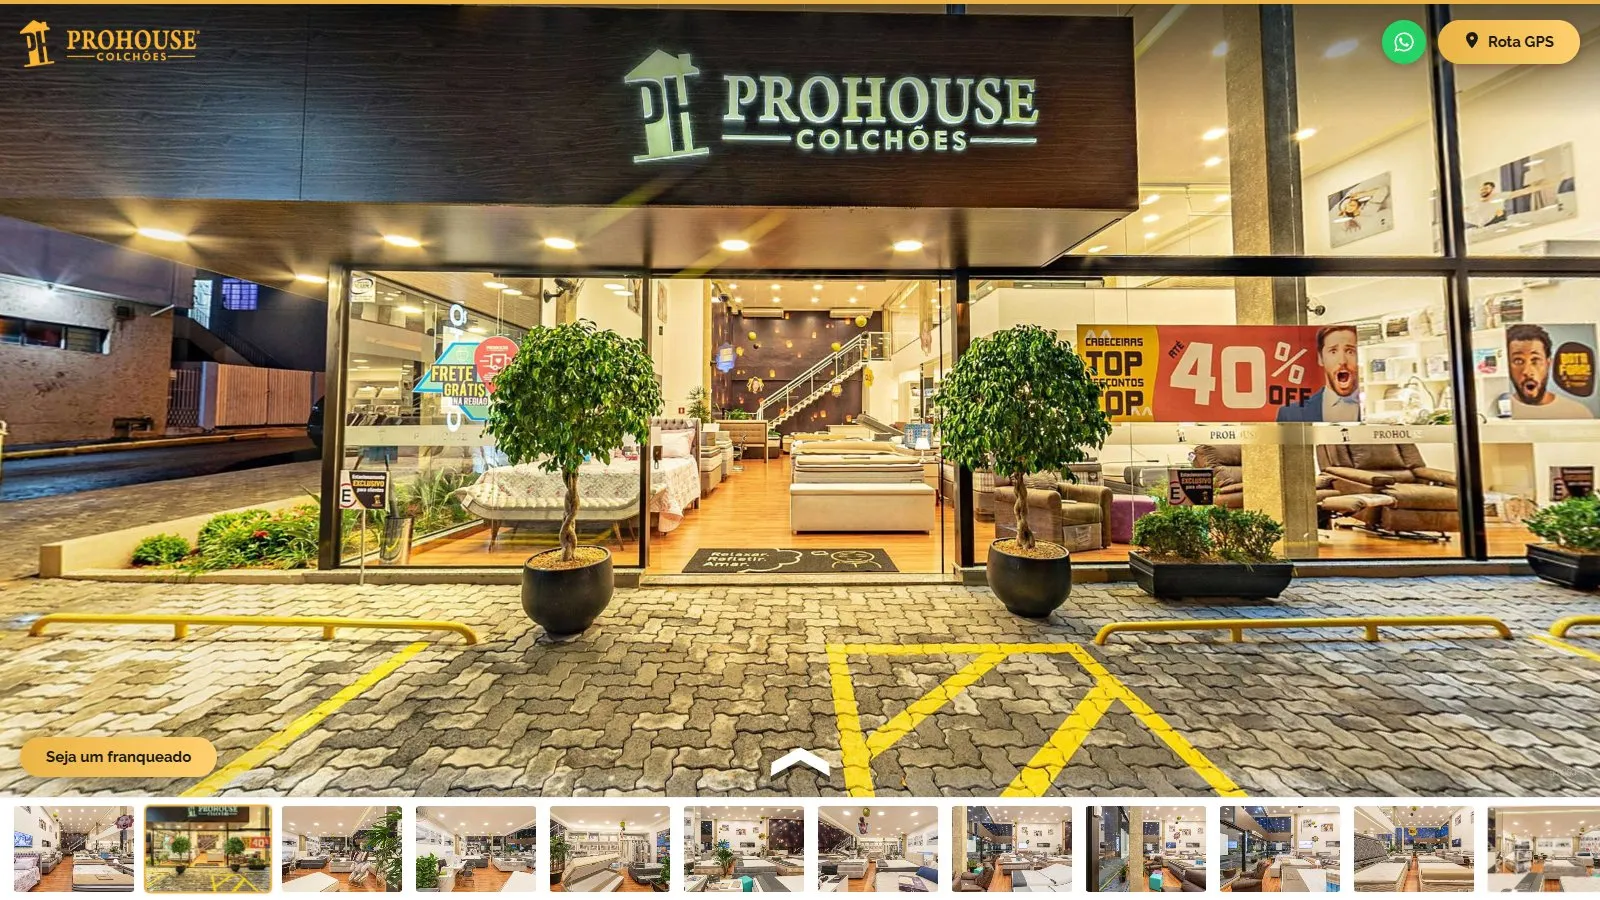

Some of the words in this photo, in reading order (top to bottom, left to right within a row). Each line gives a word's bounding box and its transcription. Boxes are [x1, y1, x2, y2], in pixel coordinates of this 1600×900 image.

[722, 74, 1040, 126] PROHOUSE
[796, 126, 967, 152] COLCHÕES
[1085, 338, 1143, 346] CABECEIRAS
[1168, 340, 1184, 358] ATÉ
[1085, 351, 1142, 376] TOP
[431, 365, 474, 382] FRETE
[444, 381, 485, 397] GRÁTIS
[1269, 385, 1312, 407] OFF
[453, 397, 463, 405] NA
[342, 489, 351, 502] E
[1171, 487, 1180, 500] E
